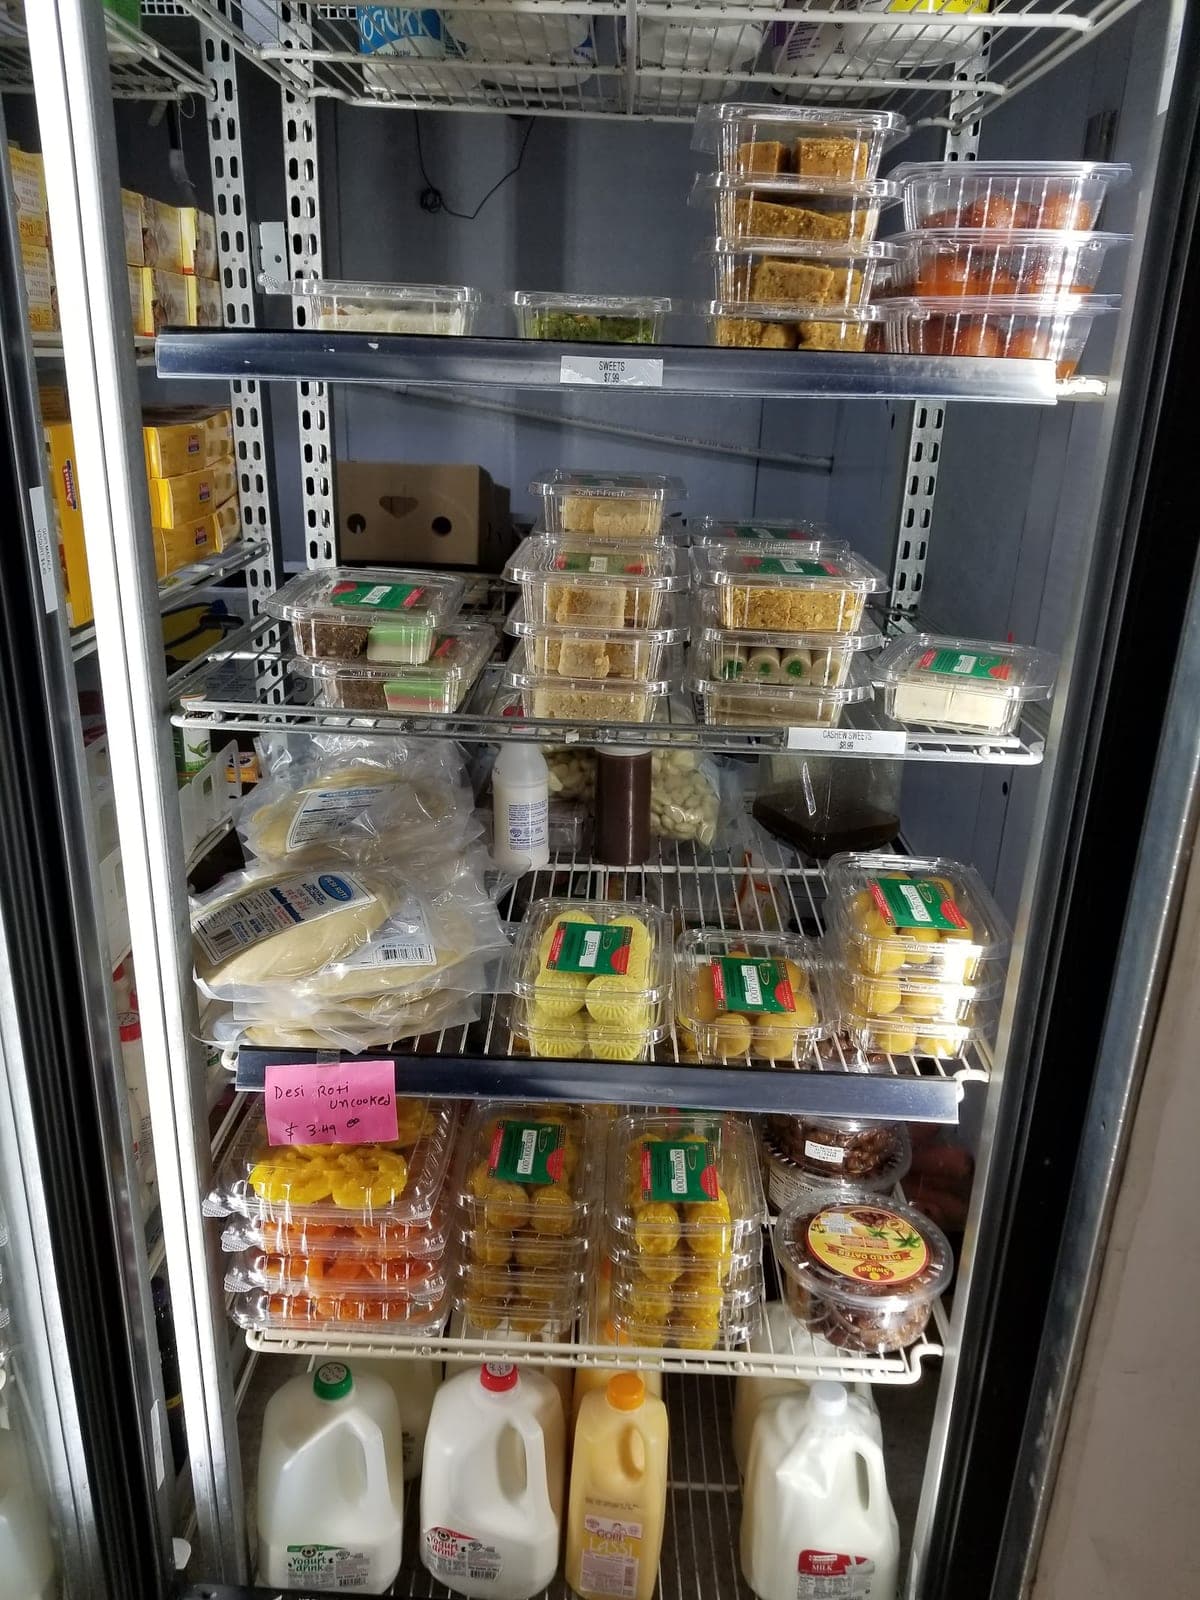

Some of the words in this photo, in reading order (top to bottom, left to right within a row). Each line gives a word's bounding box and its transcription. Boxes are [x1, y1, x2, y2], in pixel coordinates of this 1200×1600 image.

[598, 360, 625, 372] SWEETS
[603, 372, 620, 383] $7.99
[822, 730, 847, 739] CASHEW
[848, 731, 872, 741] SWEETS
[839, 740, 854, 750] $8.99
[274, 1085, 305, 1100] Desi
[317, 1081, 349, 1097] Roti
[869, 1253, 902, 1261] PITTED
[430, 1533, 458, 1551] Yogurt
[432, 1543, 457, 1558] drink
[291, 1556, 327, 1568] Yogurt
[295, 1563, 324, 1572] drink
[811, 1563, 833, 1571] MILK
